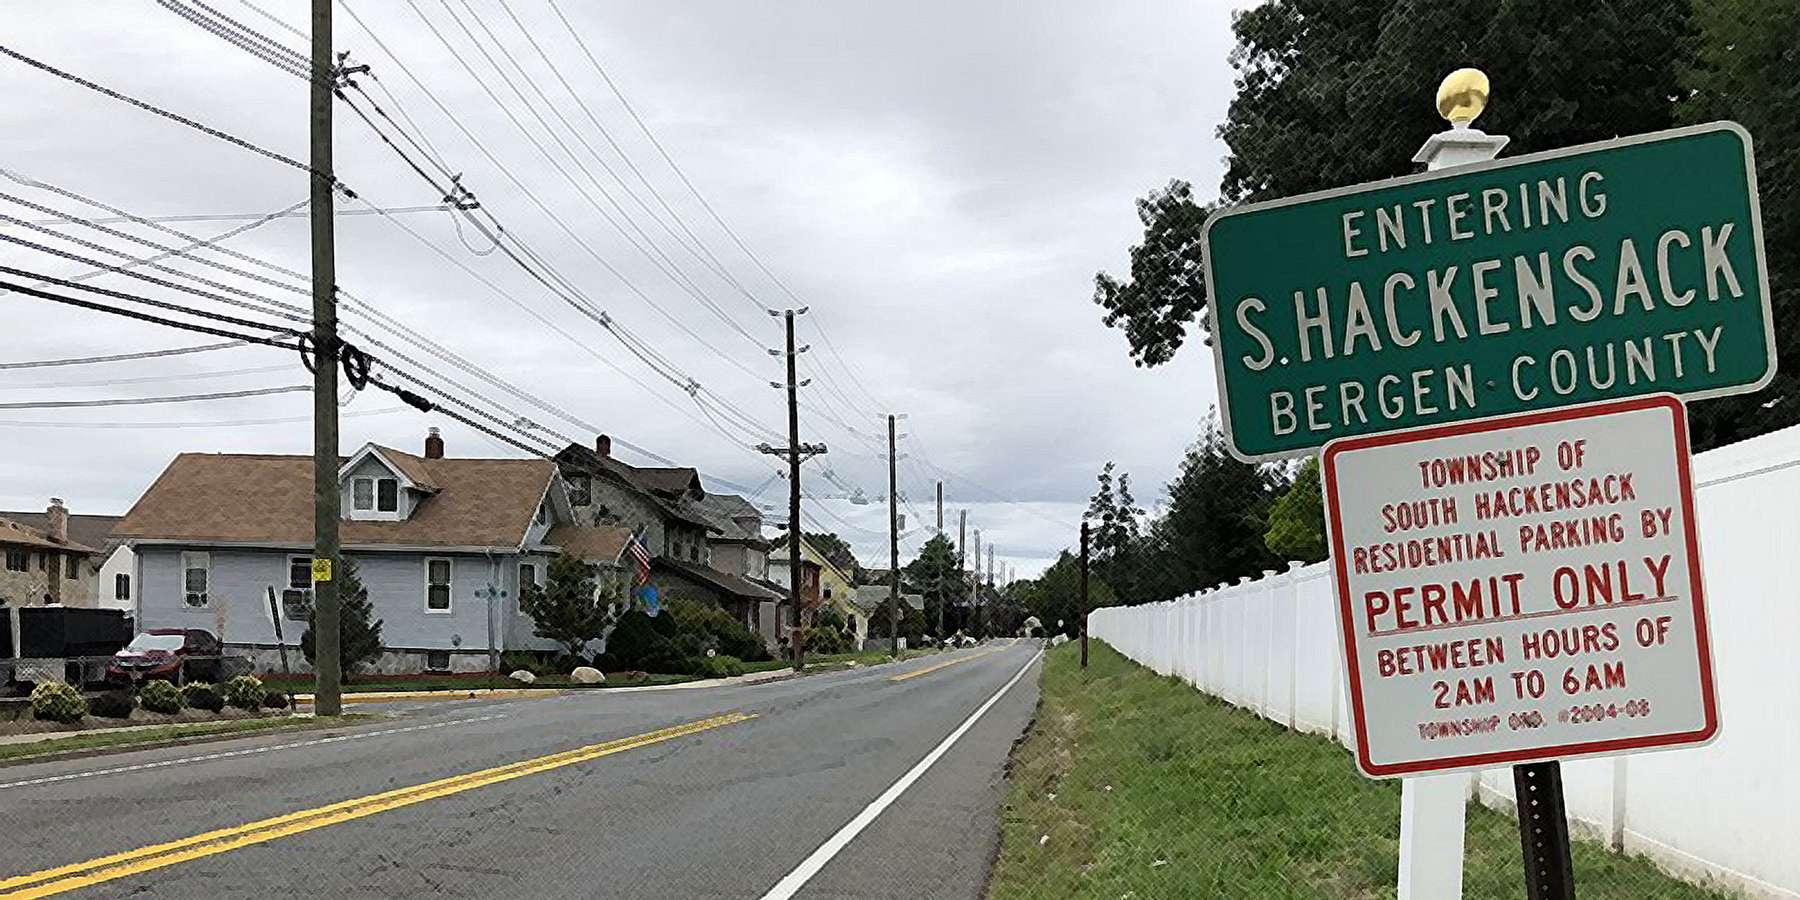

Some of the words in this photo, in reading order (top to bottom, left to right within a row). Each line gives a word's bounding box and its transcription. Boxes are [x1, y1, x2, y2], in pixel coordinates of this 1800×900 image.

[1343, 172, 1607, 257] ENTERING
[1271, 364, 1475, 435] BERGEN
[1512, 326, 1723, 400] COUNTY
[1418, 447, 1540, 489] TOWNSHIP
[1558, 440, 1586, 469] OF
[1382, 497, 1457, 533] SOUTH
[1476, 473, 1636, 520] HACKENSACK
[1353, 530, 1504, 575] RESIDENTIAL
[1520, 514, 1624, 553] PARKING
[1641, 508, 1673, 538] BY
[1365, 573, 1524, 632] PERMIT
[1553, 555, 1672, 609] ONLY
[1378, 636, 1504, 677] BETWEEN
[1522, 622, 1620, 661] HOURS
[1636, 617, 1672, 647] OF
[1433, 677, 1495, 709] 2AM
[1510, 669, 1545, 699] TO
[1562, 662, 1625, 694] 6AM
[1418, 714, 1500, 739] TOWNSHIP
